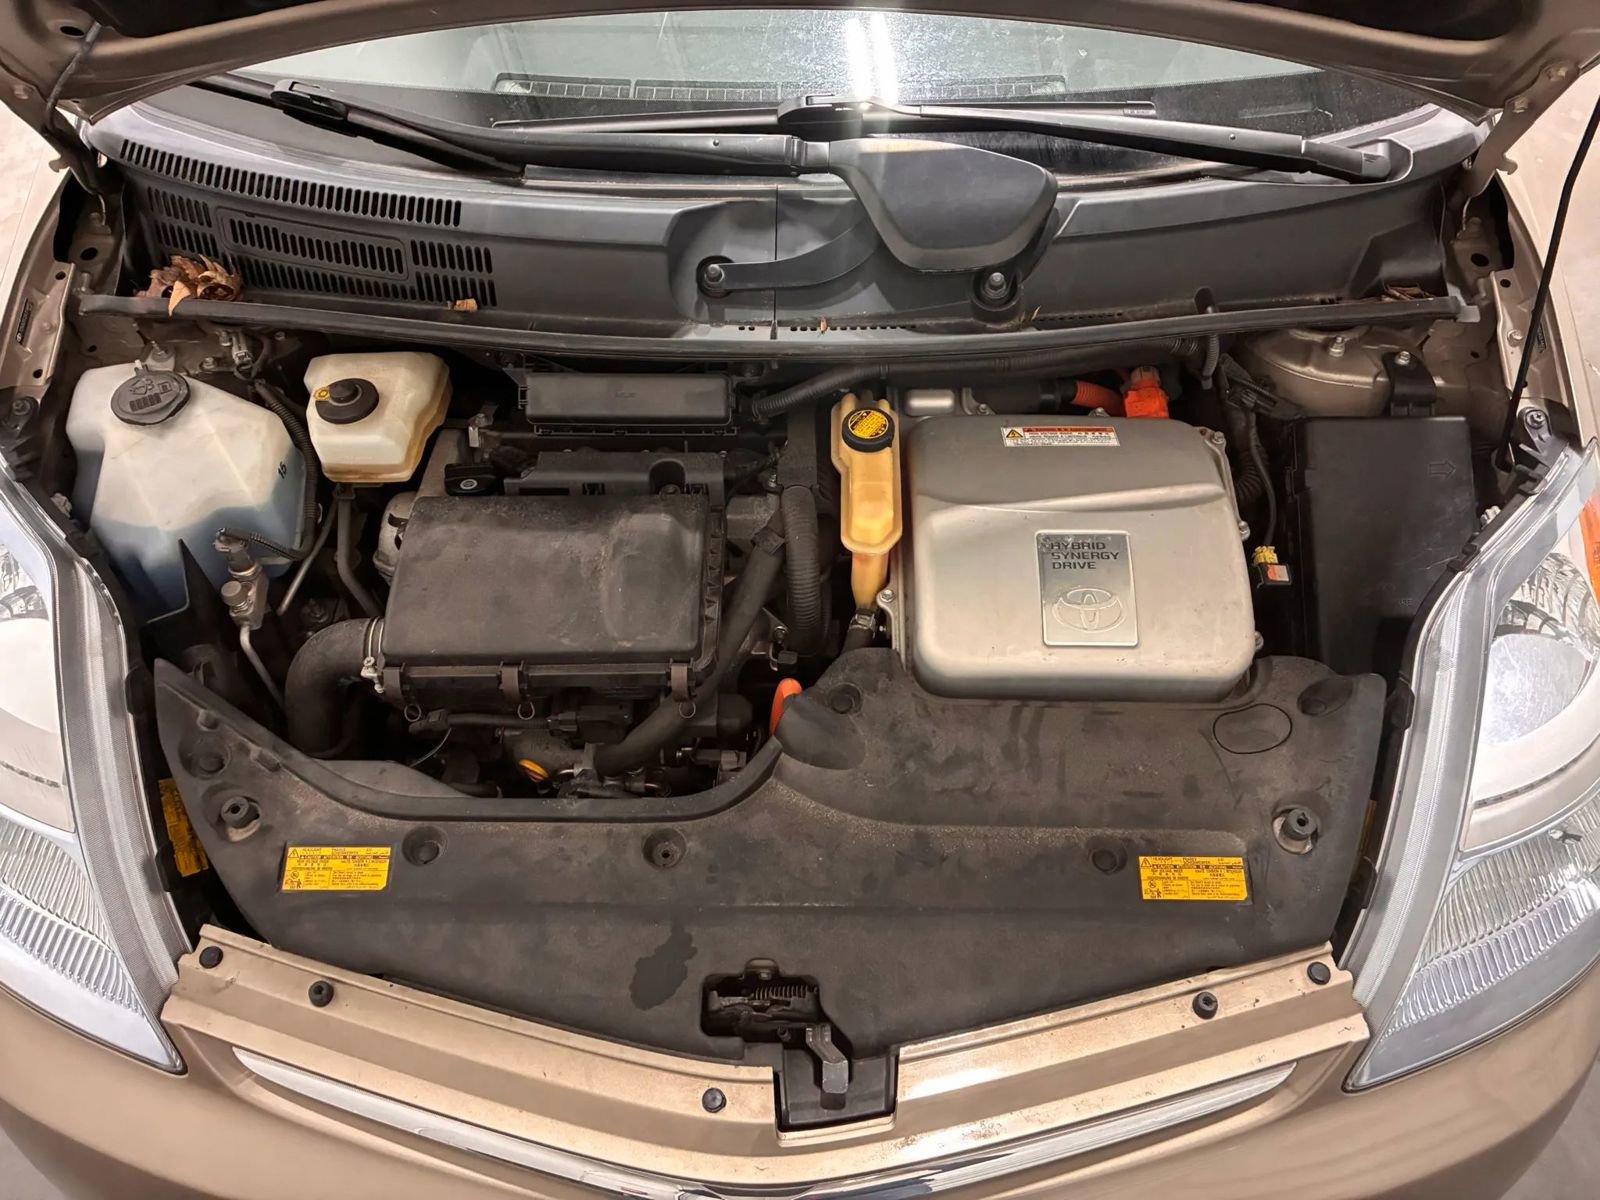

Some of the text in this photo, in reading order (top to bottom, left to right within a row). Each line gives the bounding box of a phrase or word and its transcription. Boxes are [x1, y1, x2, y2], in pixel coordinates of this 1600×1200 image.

[1050, 542, 1106, 550] HYBRID
[1051, 551, 1120, 560] SYNERGY
[1052, 561, 1097, 570] DRIVE
